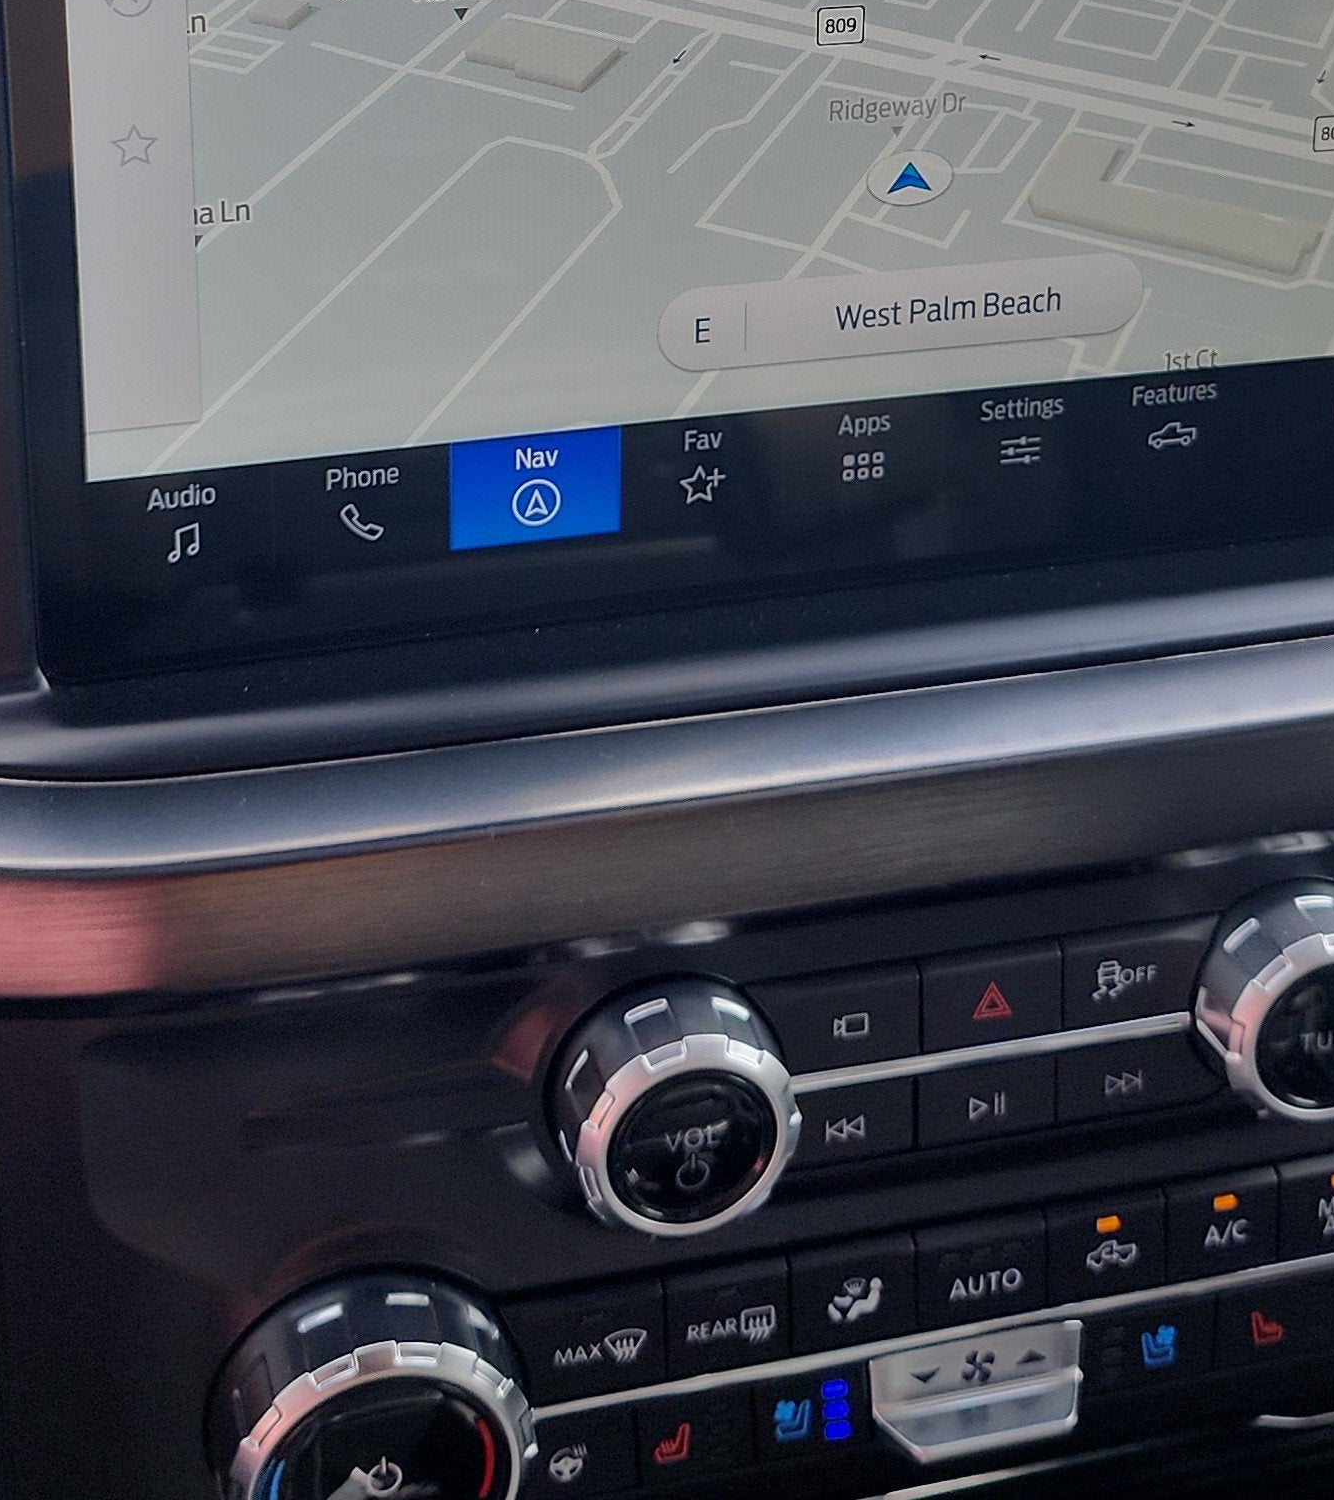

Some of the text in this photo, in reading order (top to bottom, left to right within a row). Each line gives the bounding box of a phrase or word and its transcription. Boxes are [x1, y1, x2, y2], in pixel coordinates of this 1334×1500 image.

[824, 16, 858, 34] 809
[828, 91, 967, 125] Ridgeway Dr
[220, 200, 251, 223] Ln
[835, 286, 1062, 331] West Palm Beach
[694, 316, 711, 344] E
[1131, 382, 1218, 407] Features
[979, 396, 1065, 423] Settings
[836, 412, 892, 438] Apps
[683, 428, 723, 453] Fav
[514, 446, 560, 472] Nav
[324, 464, 400, 492] Phone
[145, 483, 217, 513] Audio
[1118, 961, 1158, 987] OFF
[666, 1125, 721, 1152] VOL
[1203, 1216, 1251, 1248] A/C
[948, 1266, 1025, 1300] AUTO
[685, 1316, 738, 1343] REAR
[553, 1340, 604, 1366] MAX
